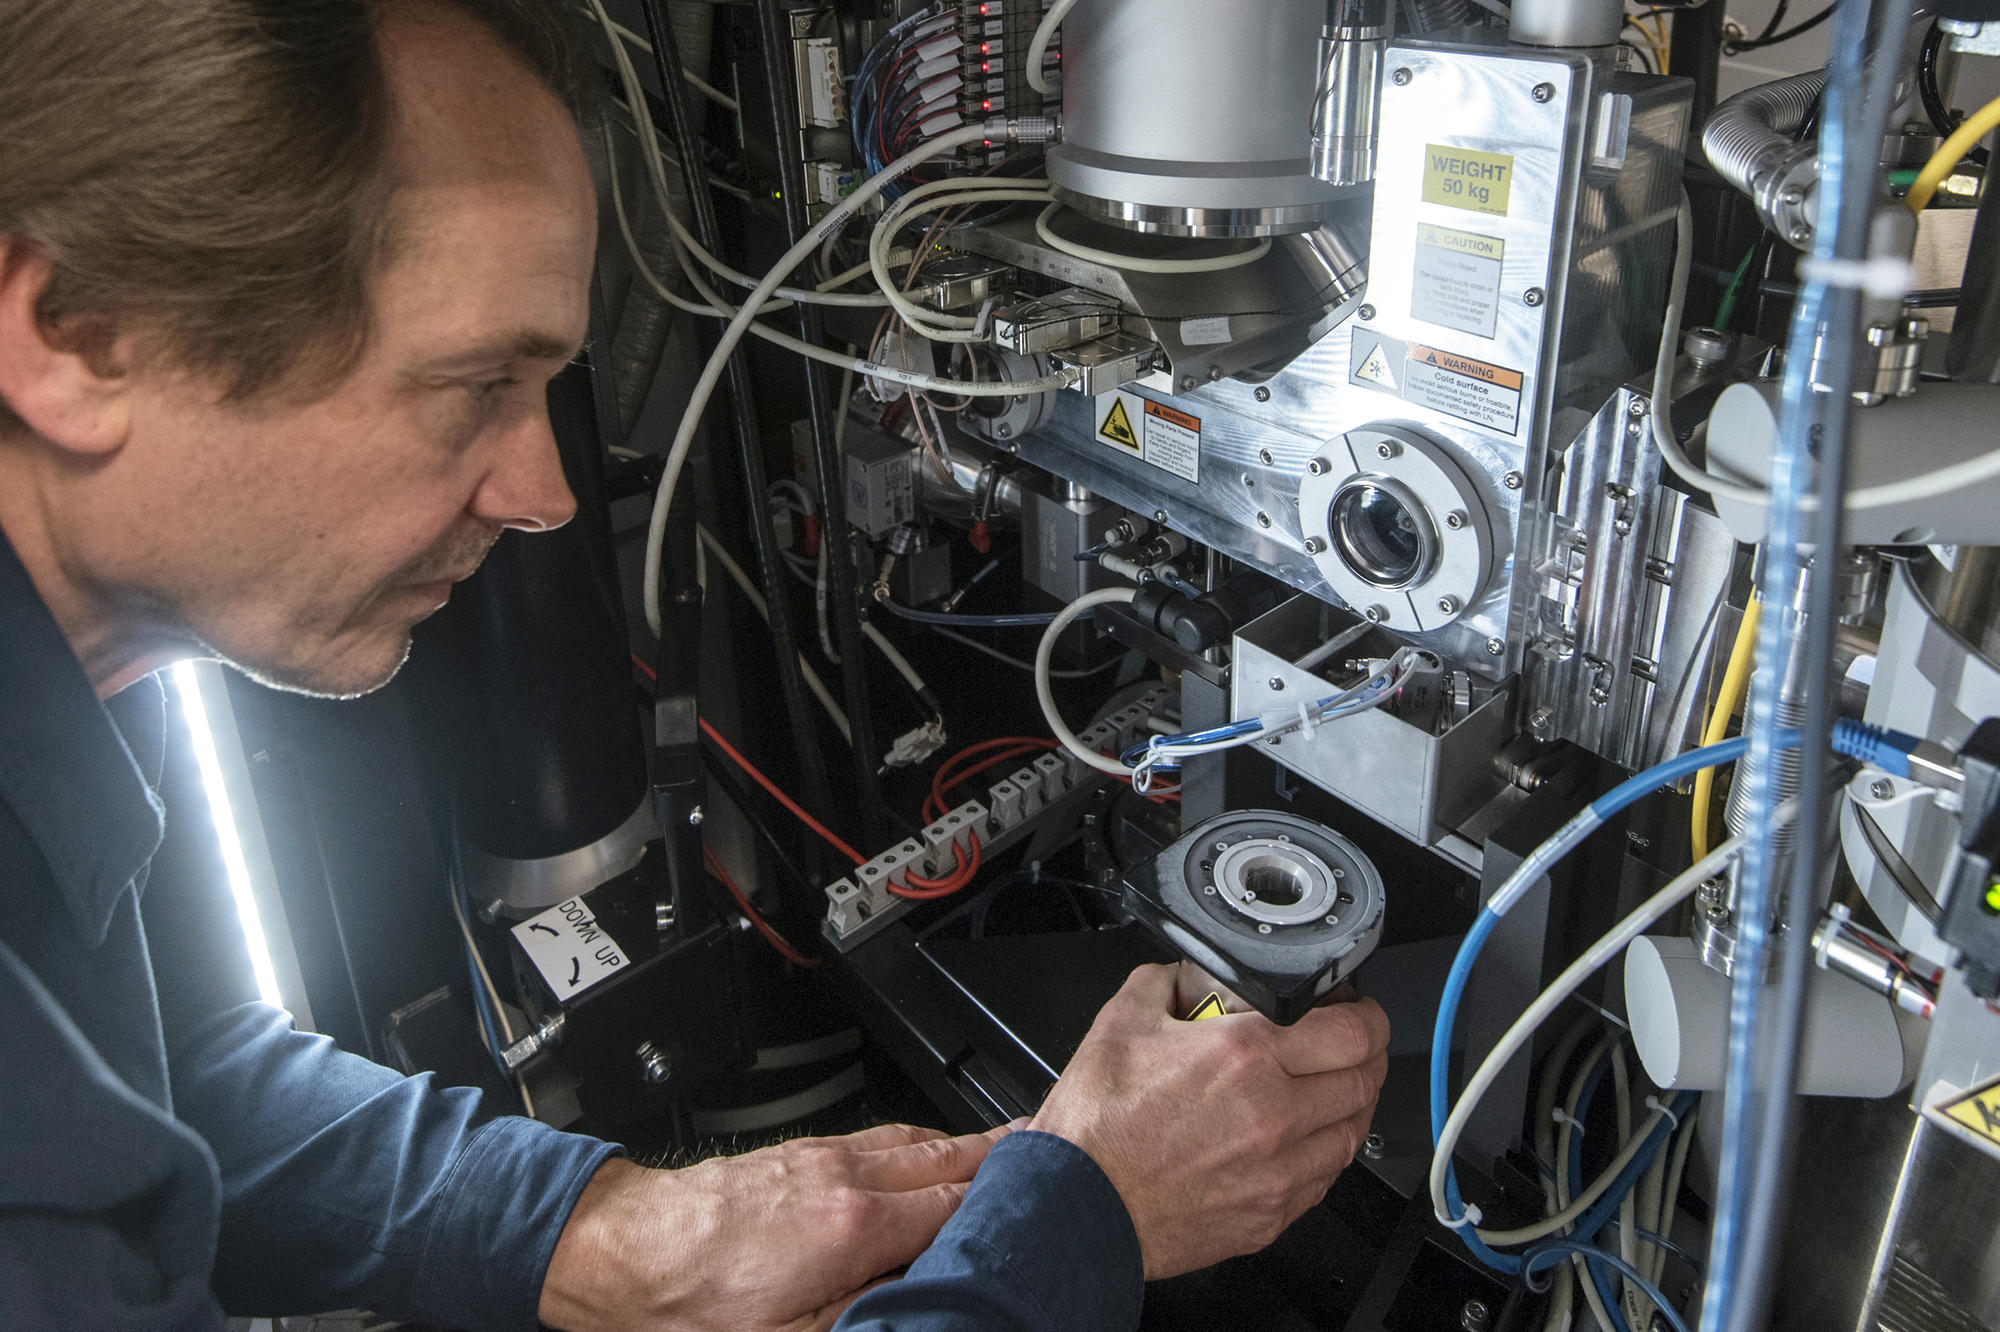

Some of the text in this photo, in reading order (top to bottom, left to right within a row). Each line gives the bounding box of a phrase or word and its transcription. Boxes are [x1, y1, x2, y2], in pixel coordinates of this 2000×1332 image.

[1432, 155, 1507, 182] WEIGHT
[1442, 178, 1490, 204] 50 kg
[1444, 234, 1493, 254] CAUTION
[1443, 356, 1494, 379] WARNING
[1434, 371, 1488, 395] Cold surface
[1458, 389, 1476, 400] burns
[1162, 409, 1191, 426] WARNING
[1462, 398, 1481, 410] safety
[1482, 404, 1514, 420] procedure
[1469, 408, 1481, 418] with
[558, 900, 601, 944] DOWN
[595, 945, 620, 966] UP
